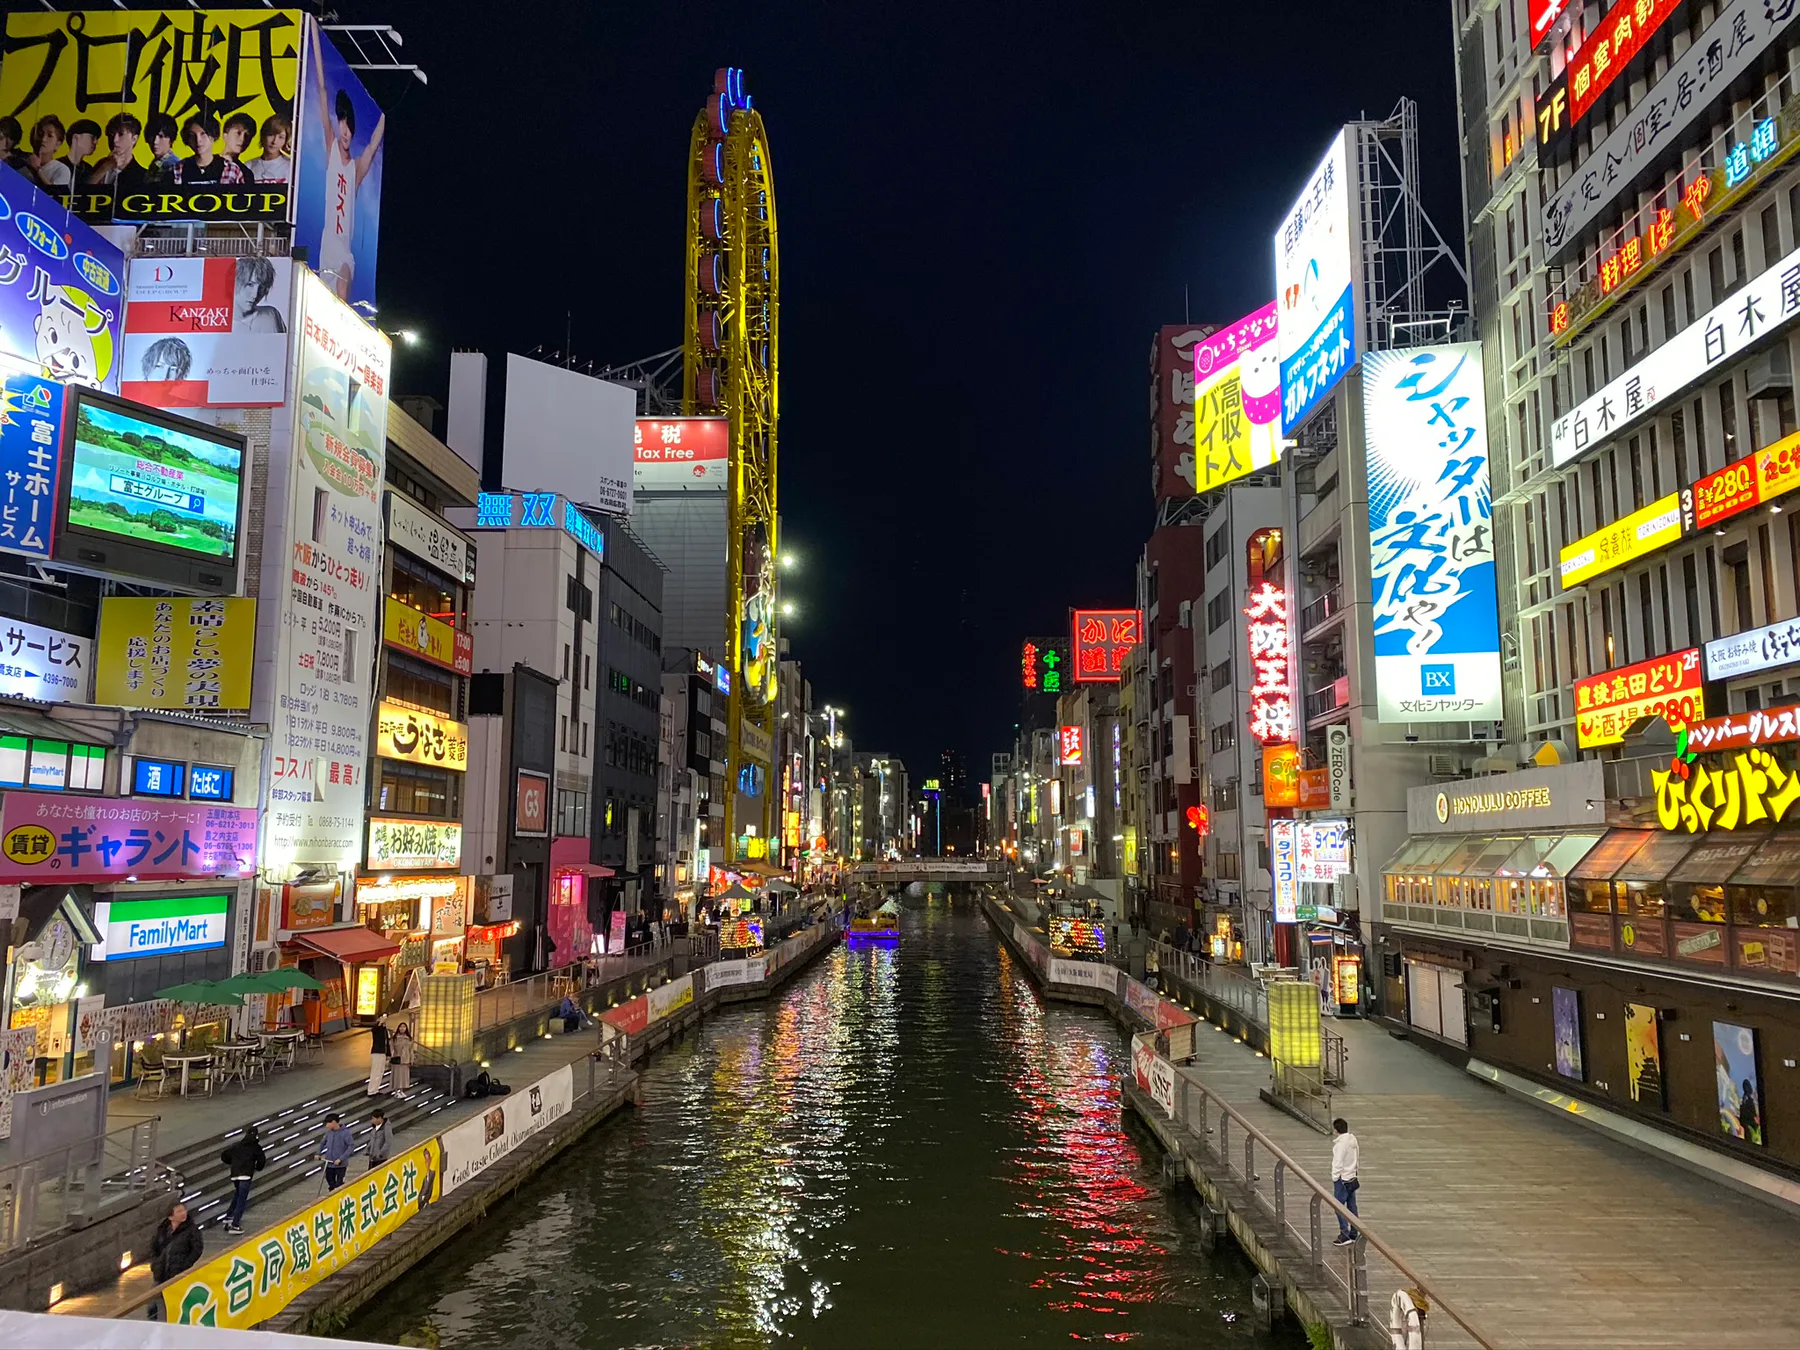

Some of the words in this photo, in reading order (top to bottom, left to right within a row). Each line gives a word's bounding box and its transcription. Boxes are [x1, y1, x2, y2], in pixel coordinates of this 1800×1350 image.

[5, 11, 298, 119] プロ彼氏
[1539, 87, 1566, 145] 7F
[1580, 9, 1755, 211] 完全個室居酒屋
[57, 194, 112, 213] EP
[122, 193, 286, 213] GROUP
[1601, 235, 1642, 293] 料理
[1726, 115, 1779, 188] 道頓
[26, 216, 59, 257] リフォーム
[169, 305, 229, 322] KANZAKI
[191, 315, 228, 331] RUKA
[1213, 308, 1278, 359] いちごなび
[206, 366, 271, 376] めっちゃ面白いを
[1283, 326, 1351, 425] ガルフネット
[1221, 376, 1243, 479] 高収入
[1555, 418, 1568, 442] 4F
[1573, 375, 1646, 451] 白木屋
[637, 448, 660, 459] Tax
[664, 447, 695, 459] Free
[1200, 386, 1220, 486] バイト
[1394, 348, 1492, 562] シャッターは
[0, 470, 21, 538] サービス
[20, 419, 55, 550] 富士ホーム
[123, 480, 183, 505] 富士グループ
[477, 491, 557, 527] 無双
[1681, 488, 1693, 532] 3F
[0, 627, 81, 668] サービス
[151, 602, 173, 697] あなたのお店づくり
[1081, 618, 1137, 644] かに
[1710, 649, 1726, 664] 大阪
[1727, 639, 1758, 660] お好み焼
[126, 637, 147, 690] 応援します
[184, 600, 226, 707] 素晴らしい夢の実現
[43, 672, 78, 689] 4396-7000
[1425, 670, 1452, 687] BX
[1577, 660, 1683, 711] 豊後高田どり
[1682, 650, 1699, 671] 2F
[392, 714, 447, 761] うなぎ
[147, 766, 161, 790] 酒
[191, 771, 220, 795] たばこ
[274, 756, 314, 780] コスパ
[1331, 747, 1344, 779] ZERO
[525, 788, 540, 818] G3
[1453, 792, 1505, 815] HONOLULU
[1505, 786, 1551, 810] COFFEE
[11, 834, 49, 856] 賃貸
[51, 858, 60, 869] の
[57, 824, 201, 868] ギャラント
[390, 824, 437, 856] お好み焼
[130, 919, 208, 947] FamilyMart
[224, 1160, 418, 1314] 合同衛生株式会社
